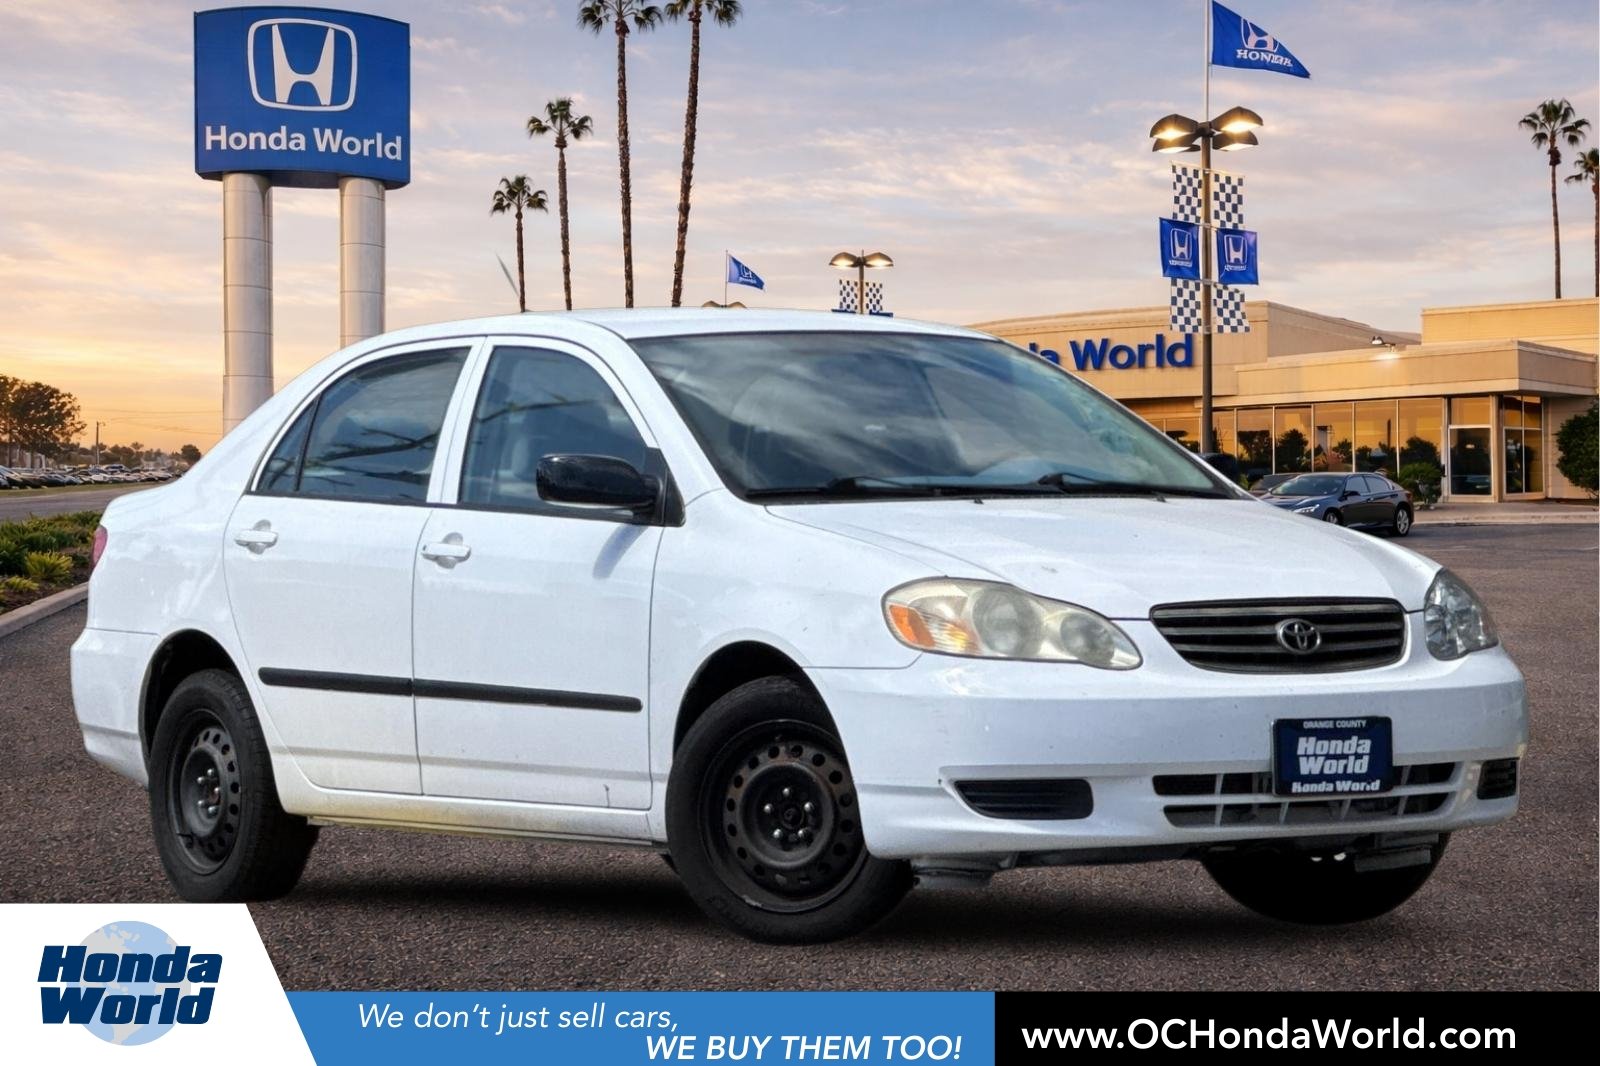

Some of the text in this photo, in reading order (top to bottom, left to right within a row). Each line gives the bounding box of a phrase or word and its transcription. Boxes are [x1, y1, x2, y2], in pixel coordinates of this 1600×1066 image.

[205, 125, 402, 161] Honda World
[1069, 333, 1193, 371] World
[1303, 720, 1367, 729] ORANGE COUNTY
[1296, 735, 1372, 756] Honda
[1298, 754, 1370, 775] World
[1291, 781, 1334, 793] Honda
